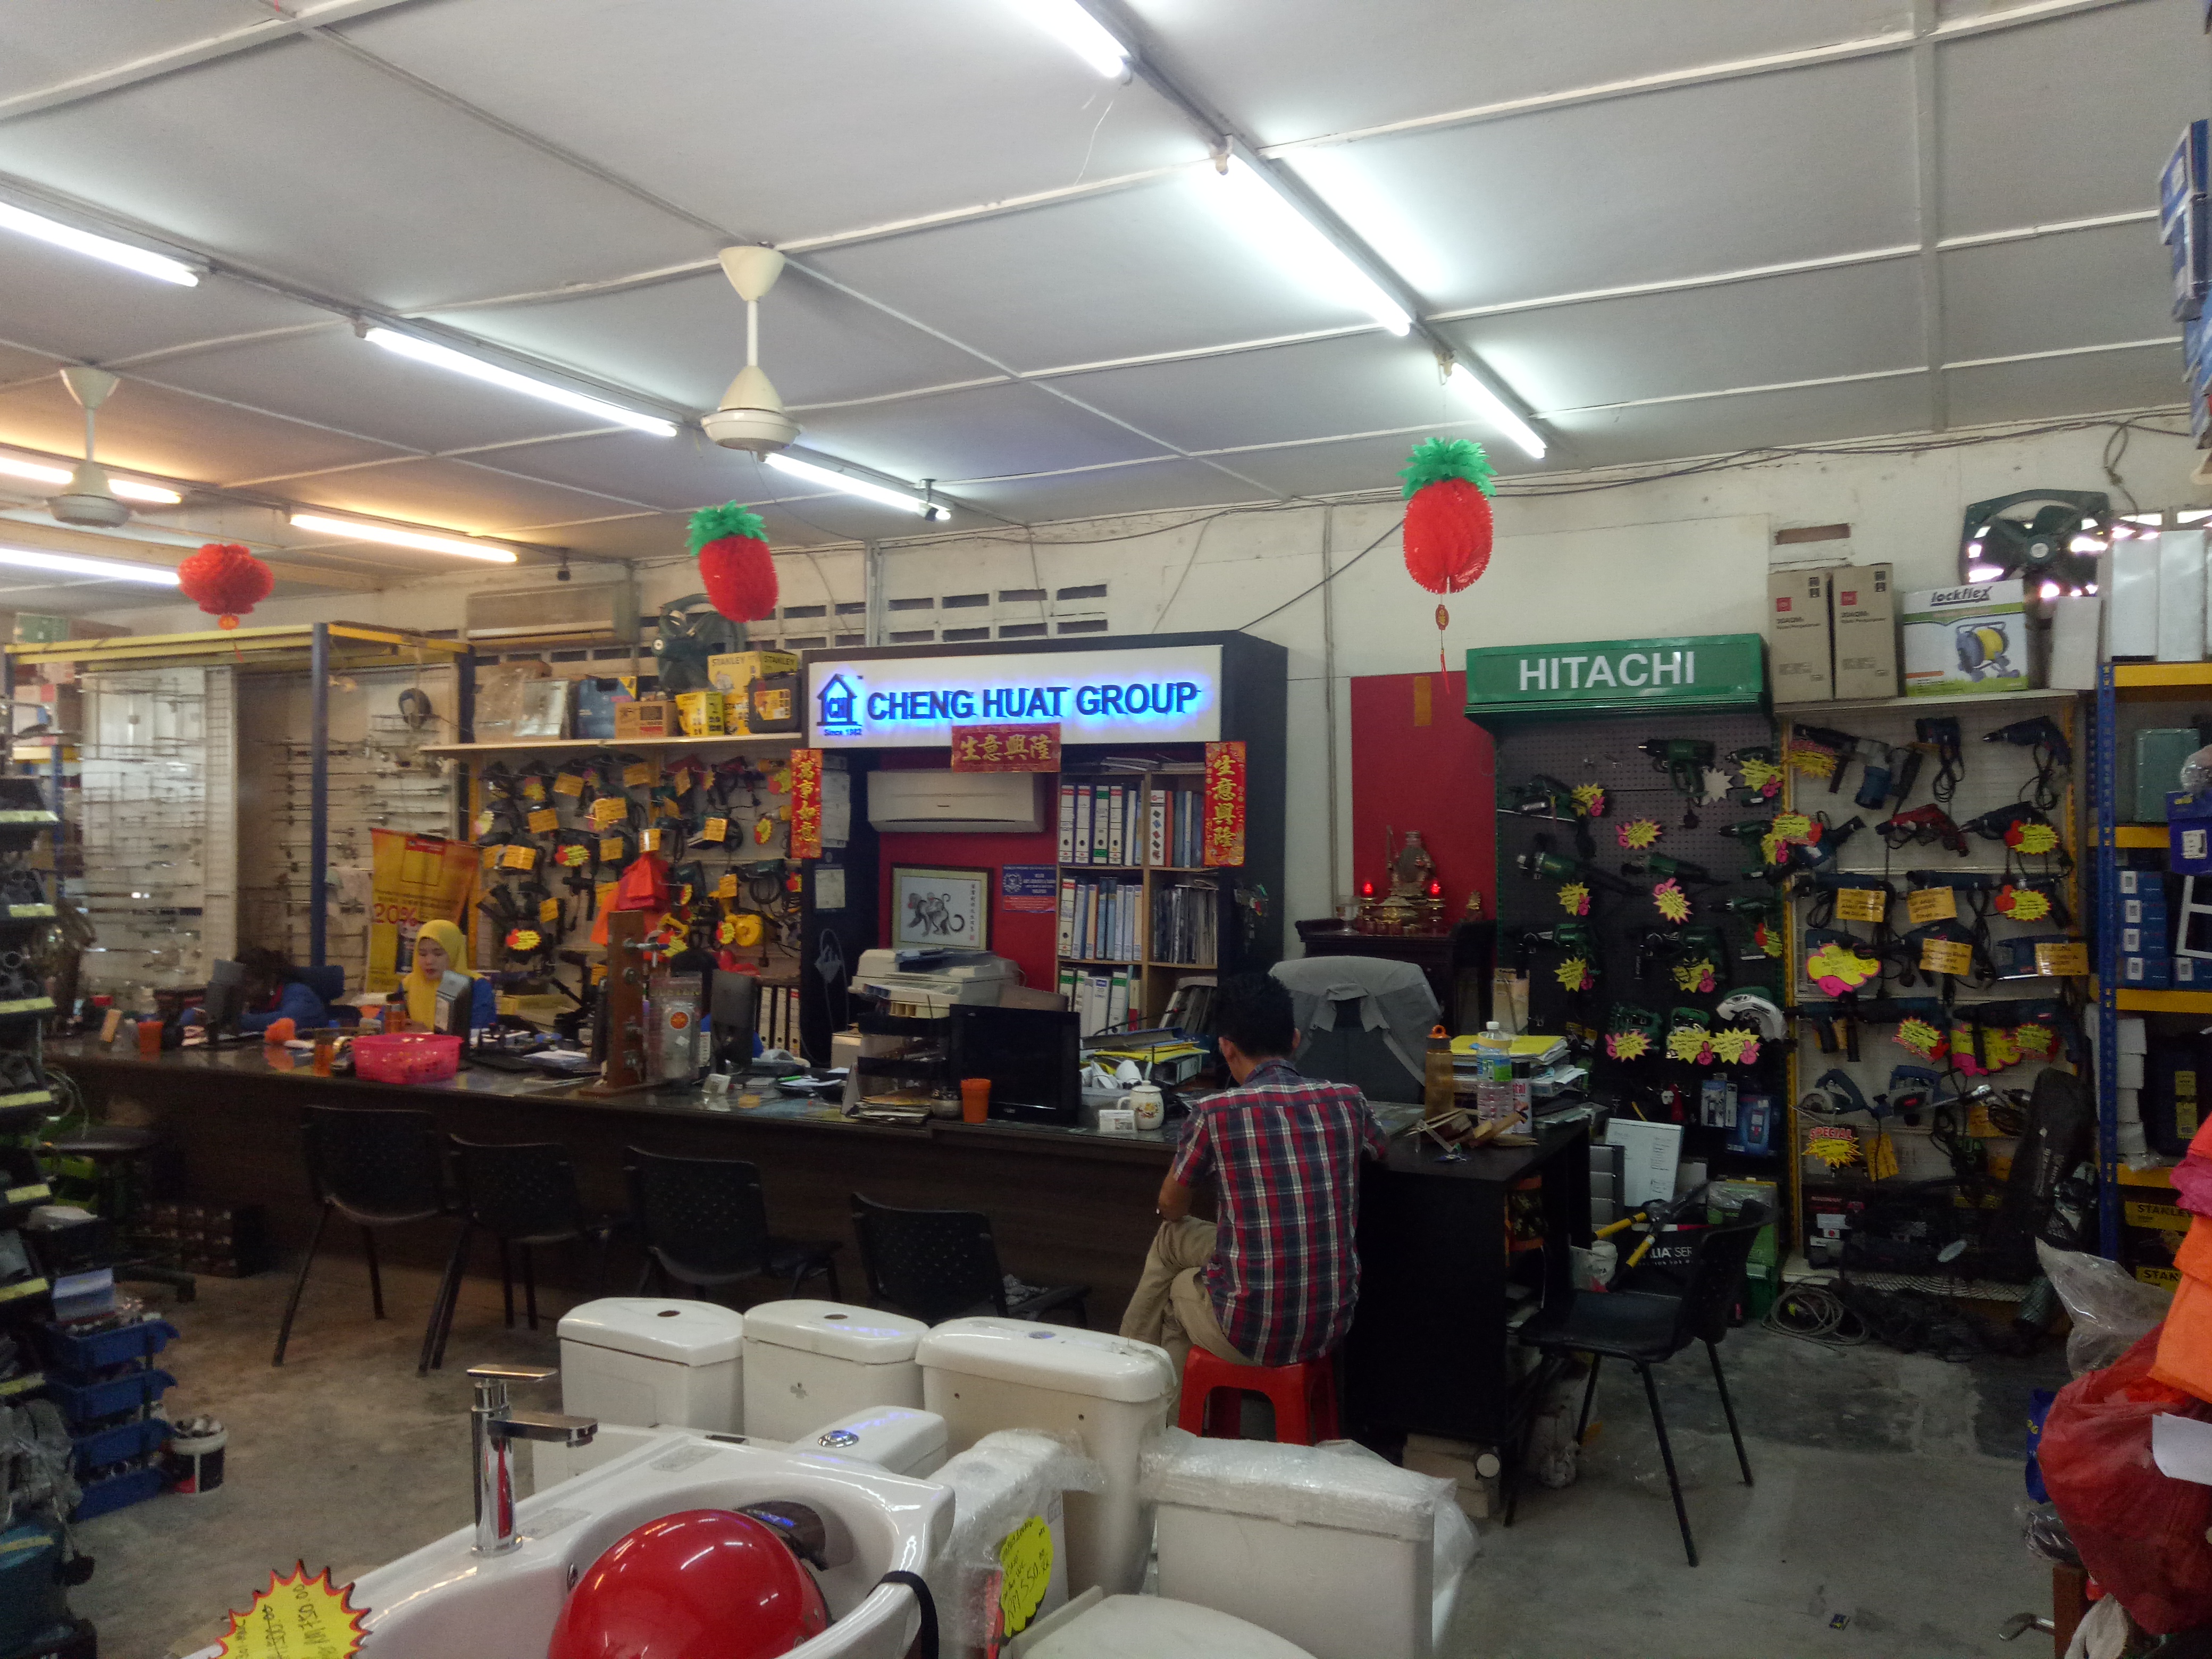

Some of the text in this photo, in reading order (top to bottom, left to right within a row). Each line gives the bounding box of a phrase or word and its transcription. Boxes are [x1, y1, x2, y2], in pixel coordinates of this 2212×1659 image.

[1931, 586, 1993, 603] lockflex
[1519, 651, 1695, 691] HITACHI
[867, 682, 1199, 720] CHENG HUAT GROUP
[960, 733, 1053, 763] 生意興隆
[1211, 755, 1237, 848] 生意興隆
[1809, 1126, 1853, 1141] SPECIAL
[2143, 1269, 2179, 1281] STAN
